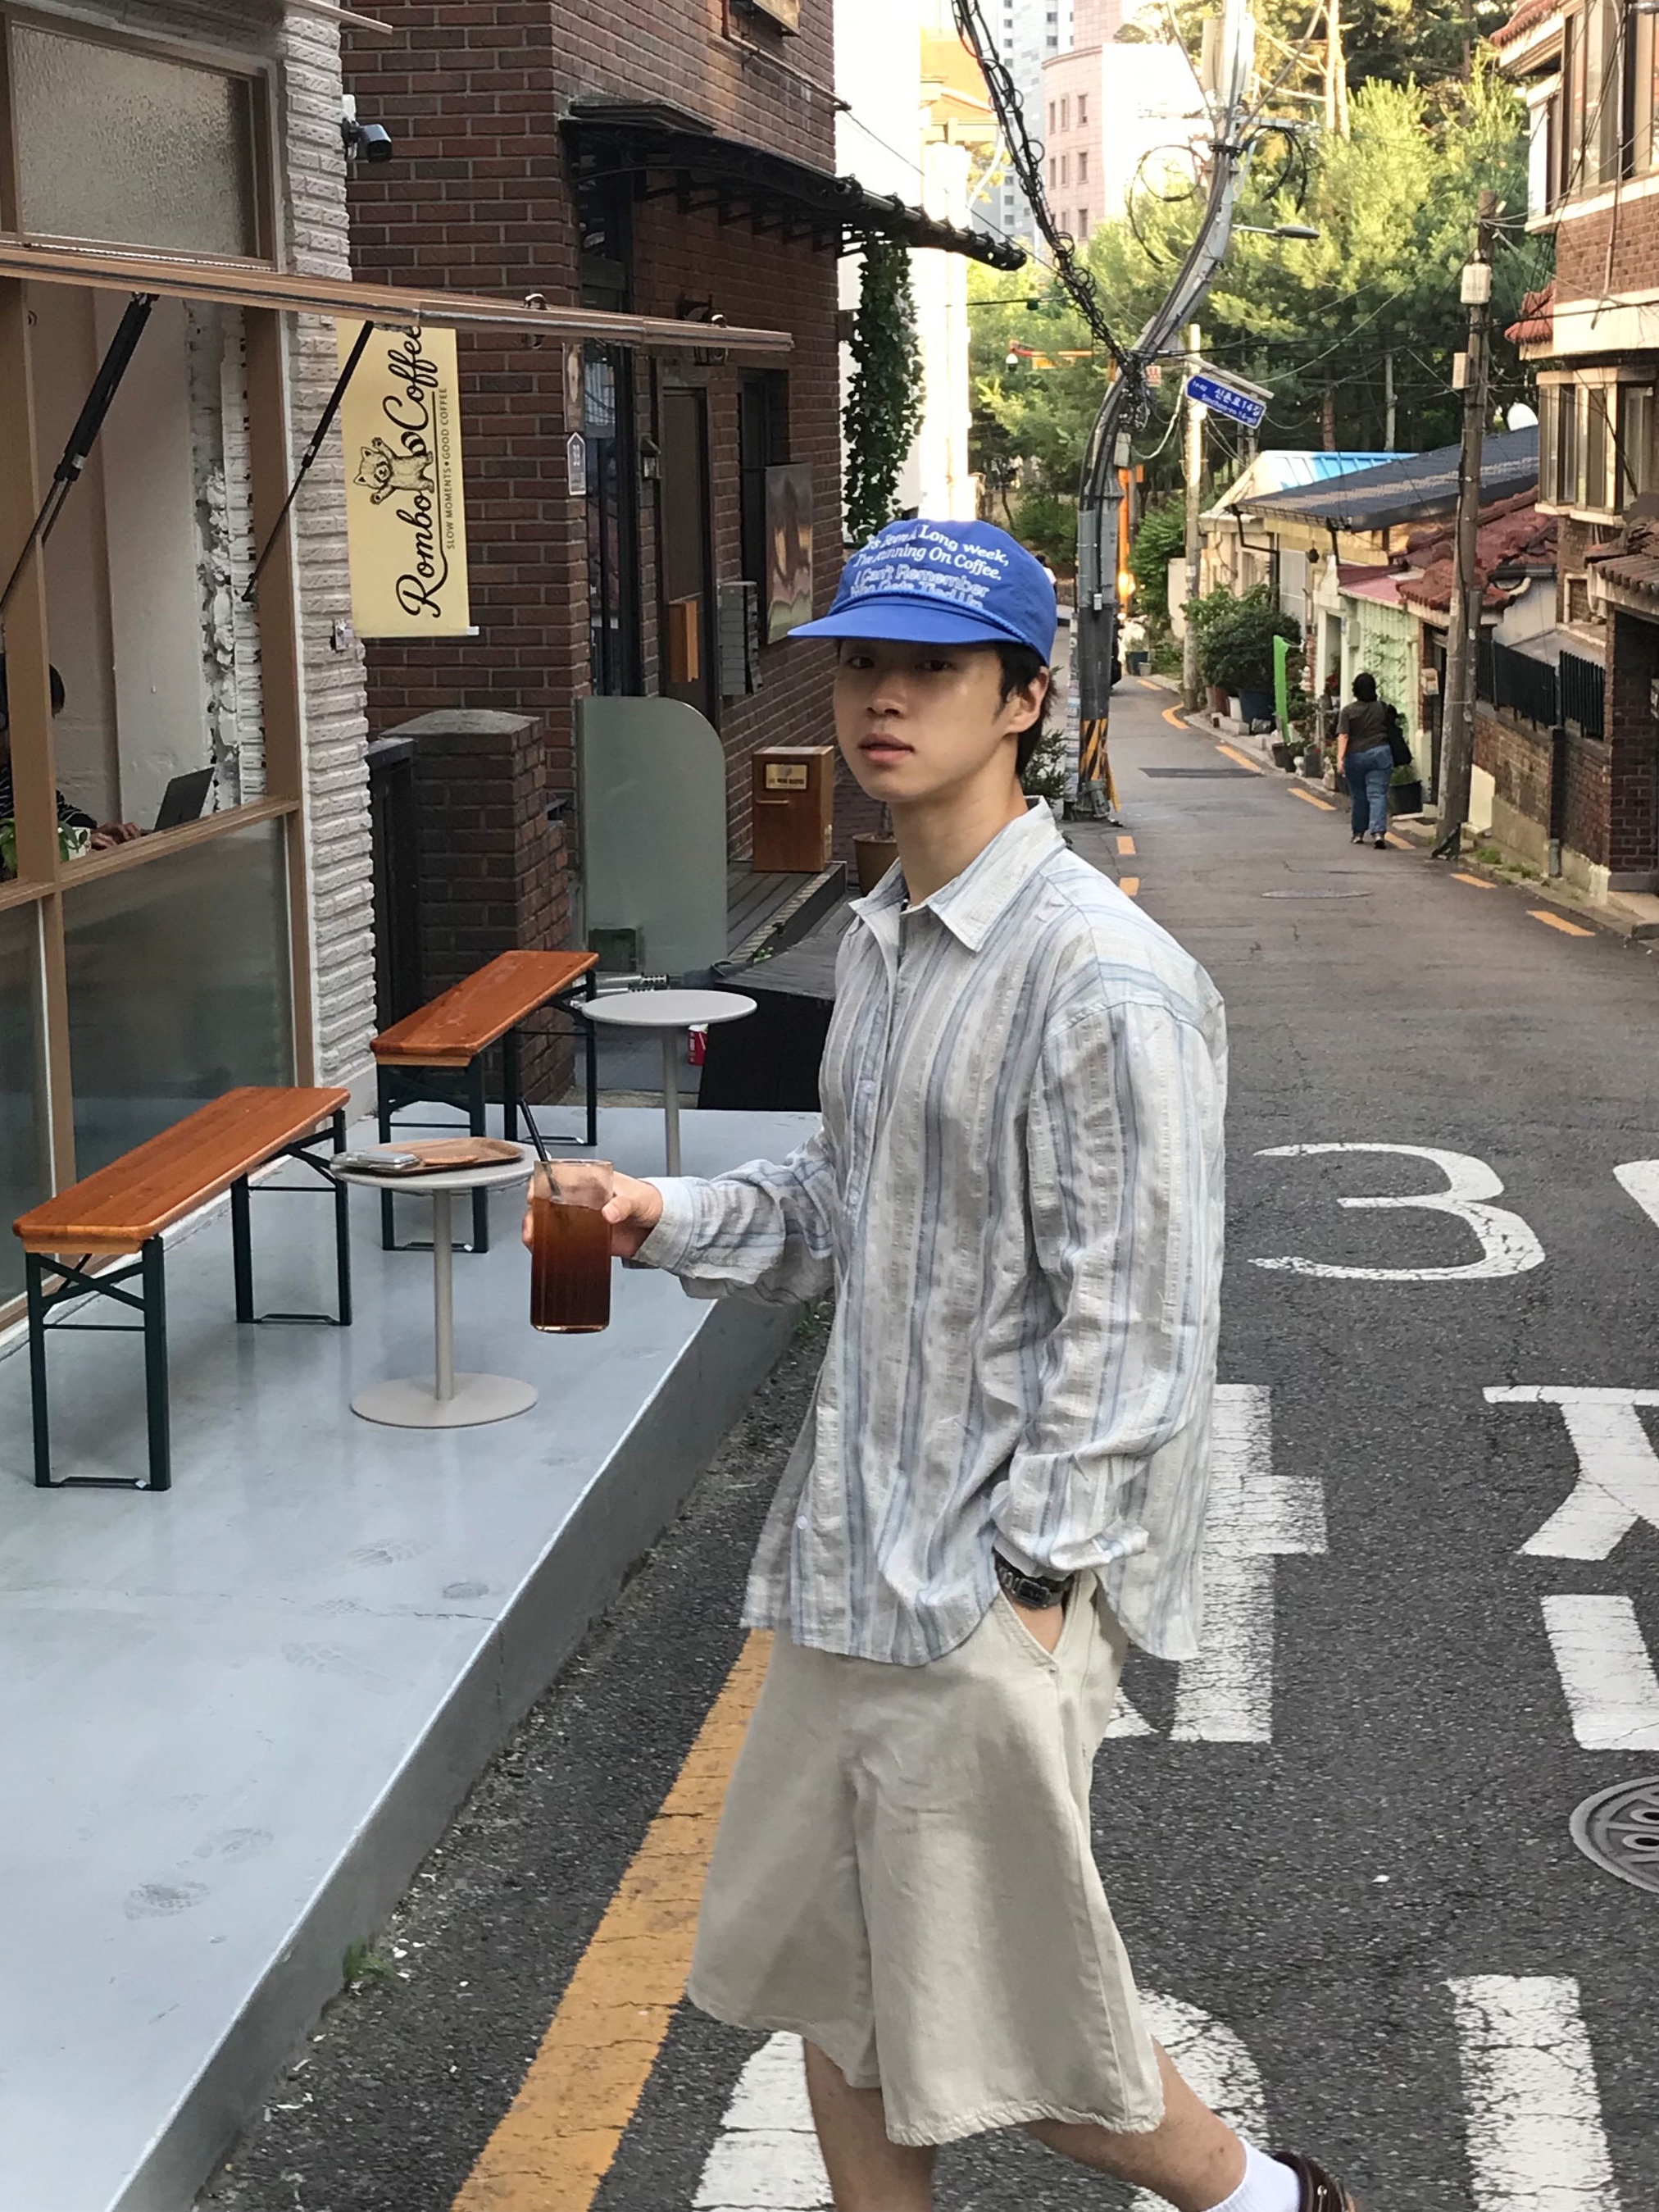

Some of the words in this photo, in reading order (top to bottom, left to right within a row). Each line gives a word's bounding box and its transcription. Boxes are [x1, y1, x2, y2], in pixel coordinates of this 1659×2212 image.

[382, 326, 439, 431] Coffee
[439, 388, 449, 426] COFFEE
[440, 429, 451, 460] GOOD
[443, 468, 453, 518] MOMENTS
[446, 522, 455, 549] SLOW
[918, 525, 958, 552] Long
[962, 543, 1009, 567] week,
[395, 492, 448, 618] Rombo
[929, 546, 952, 564] On
[954, 553, 1002, 580] Coffee.
[861, 564, 894, 583] Can't
[895, 563, 990, 598] Remember
